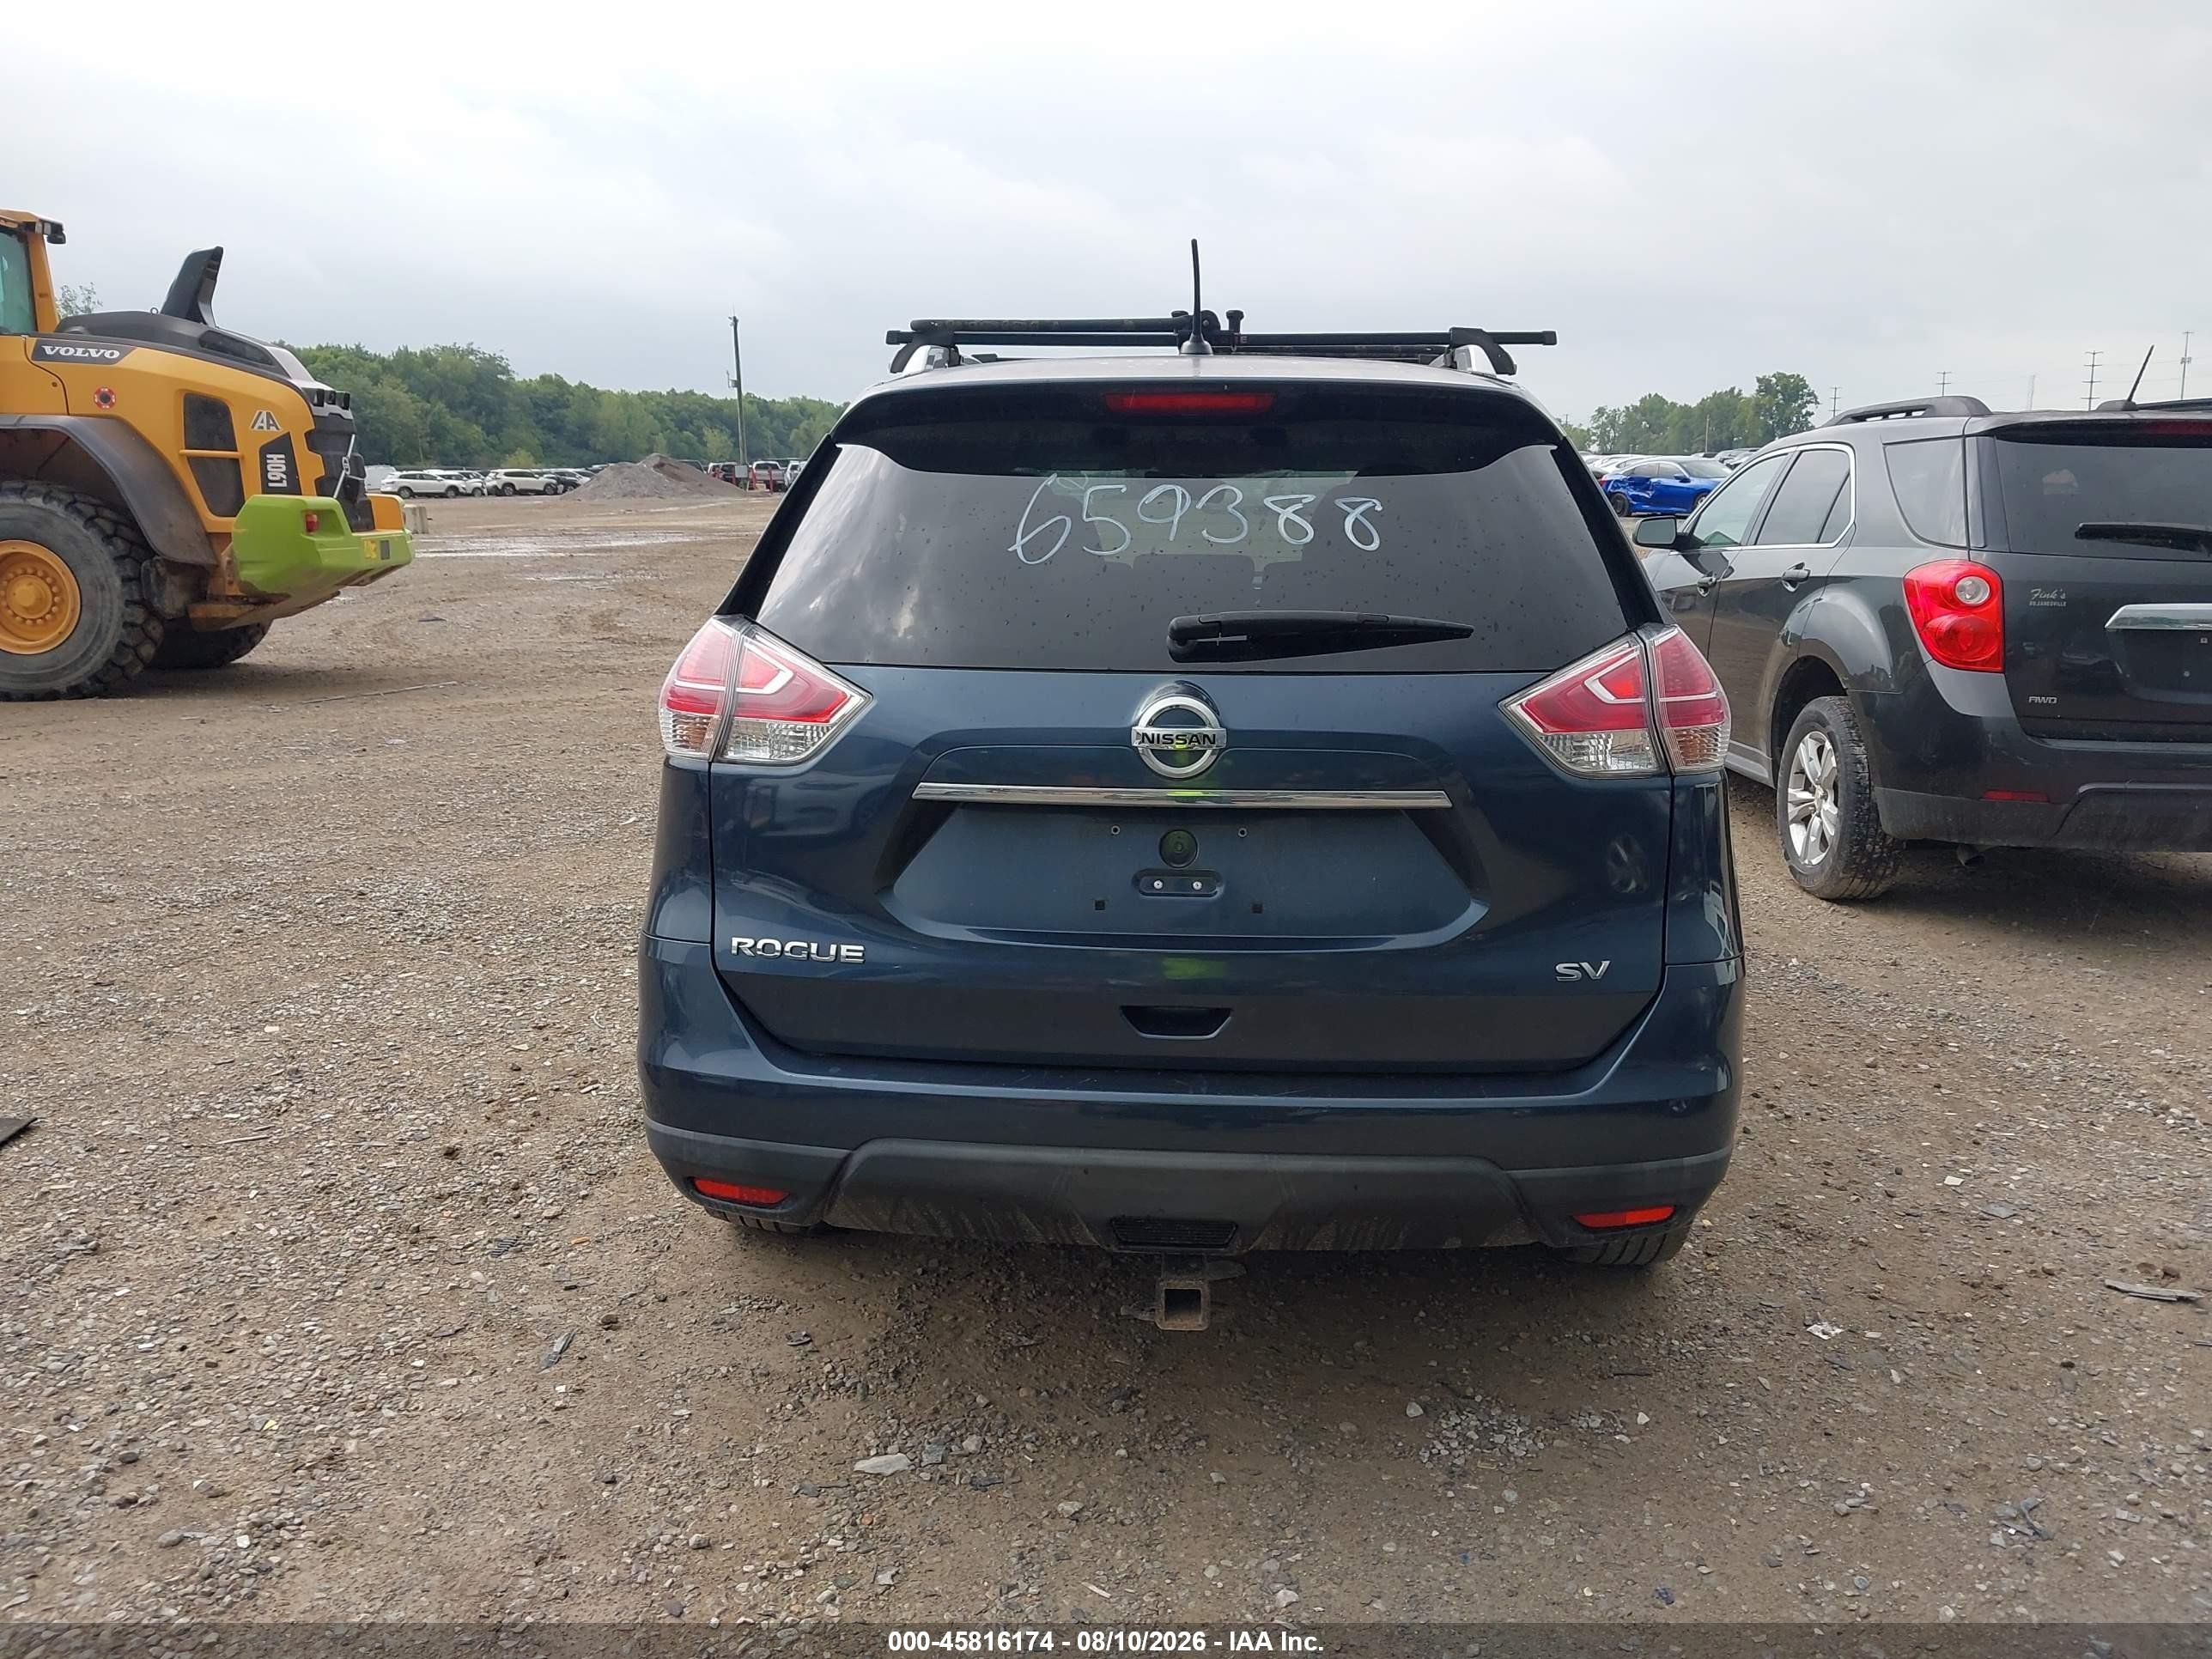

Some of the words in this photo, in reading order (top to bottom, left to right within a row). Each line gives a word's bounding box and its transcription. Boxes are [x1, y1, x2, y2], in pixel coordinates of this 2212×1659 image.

[40, 345, 120, 359] VOLVO
[266, 453, 288, 488] L90H
[1008, 473, 1382, 564] 659388
[2028, 696, 2057, 704] AWD
[1141, 732, 1216, 745] NISSAN
[731, 937, 865, 963] ROGUE
[1555, 960, 1611, 981] SV
